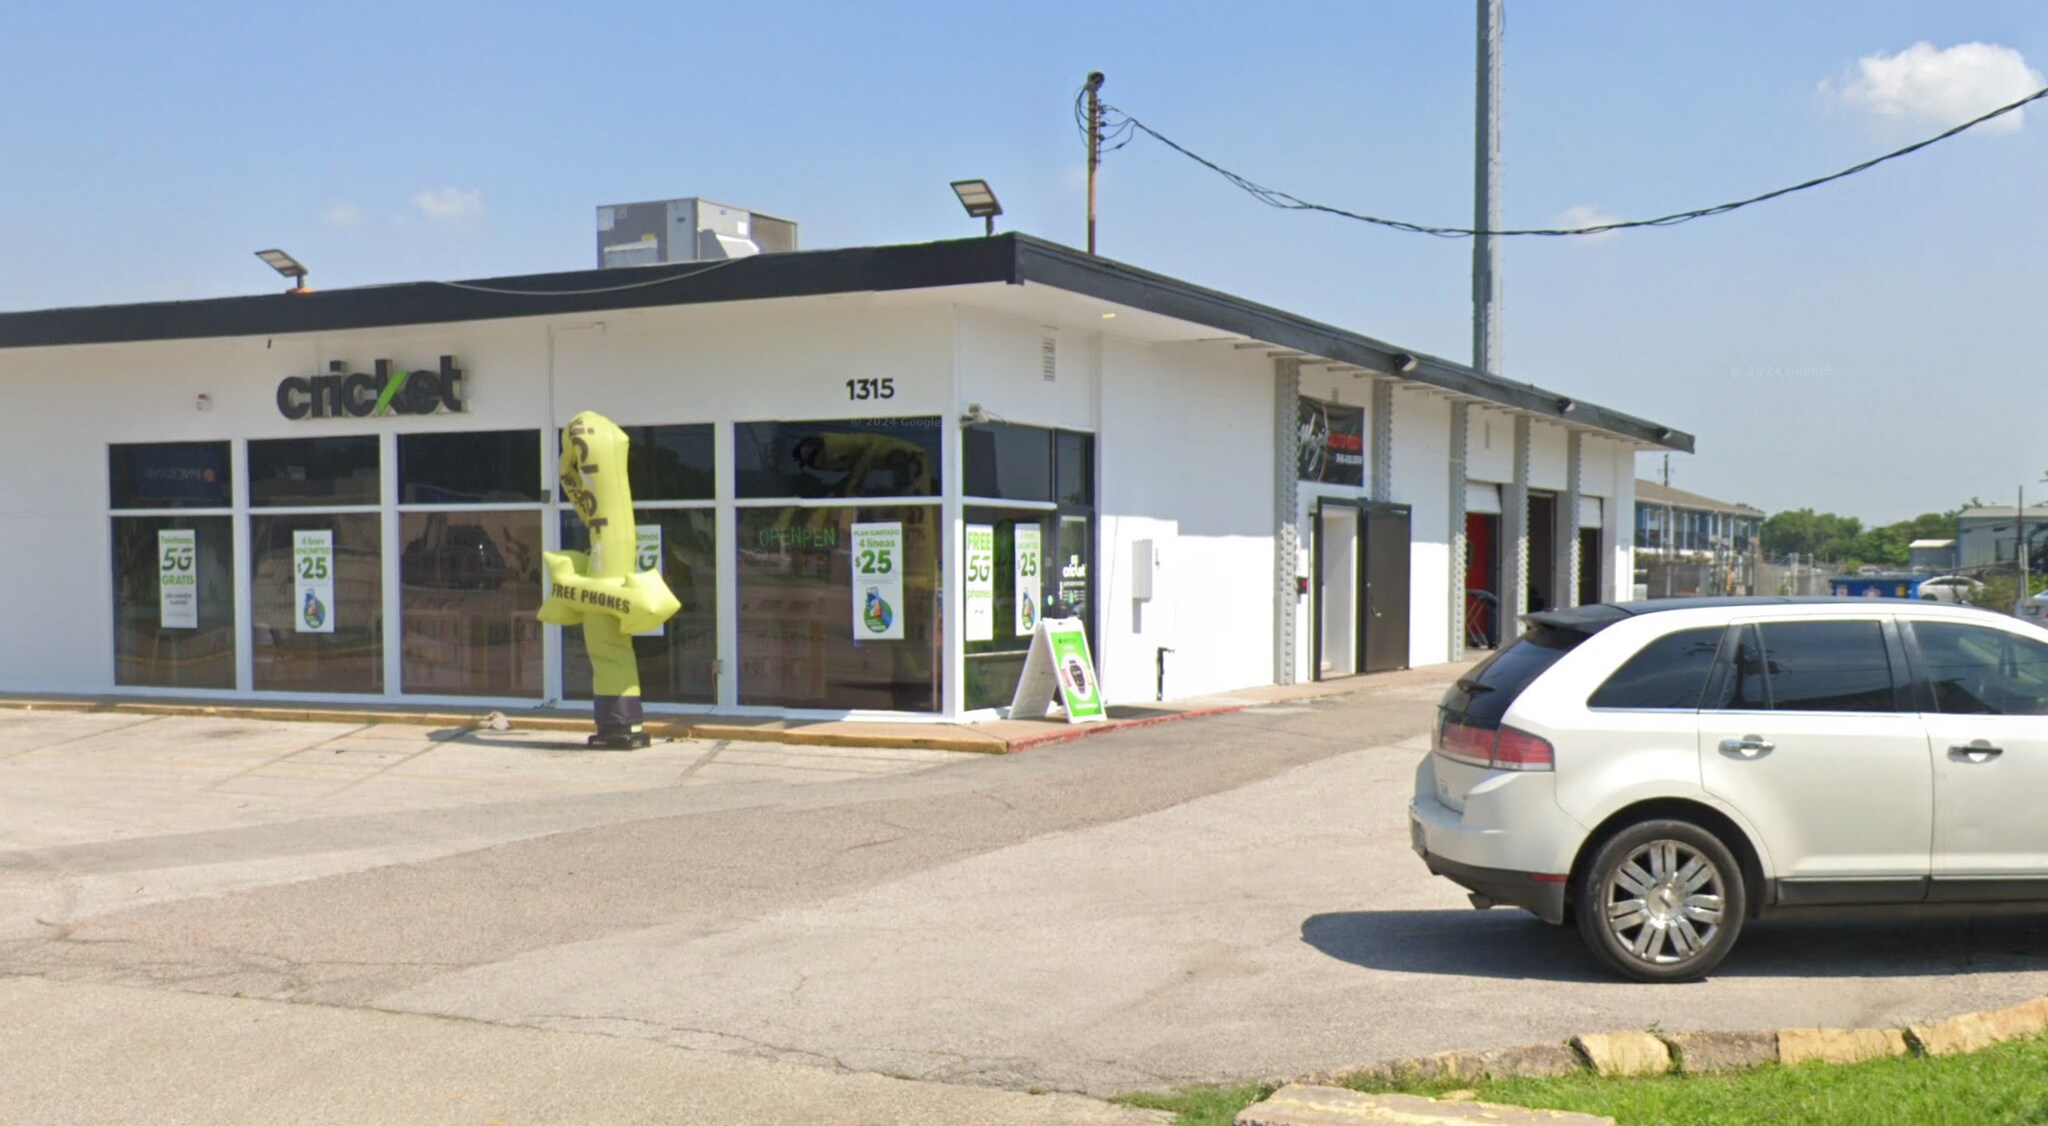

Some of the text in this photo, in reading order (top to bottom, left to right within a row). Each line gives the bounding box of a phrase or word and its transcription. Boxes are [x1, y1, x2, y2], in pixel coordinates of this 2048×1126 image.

[277, 355, 463, 420] cricket
[846, 378, 895, 400] 1315
[859, 538, 865, 547] 4
[967, 532, 991, 551] FREE
[162, 547, 193, 571] 5G
[297, 556, 328, 579] $25
[855, 549, 892, 574] $25
[967, 555, 990, 582] 5G
[162, 575, 195, 586] GRATIS
[552, 583, 630, 613] FREE PHONES
[967, 588, 991, 599] phones
